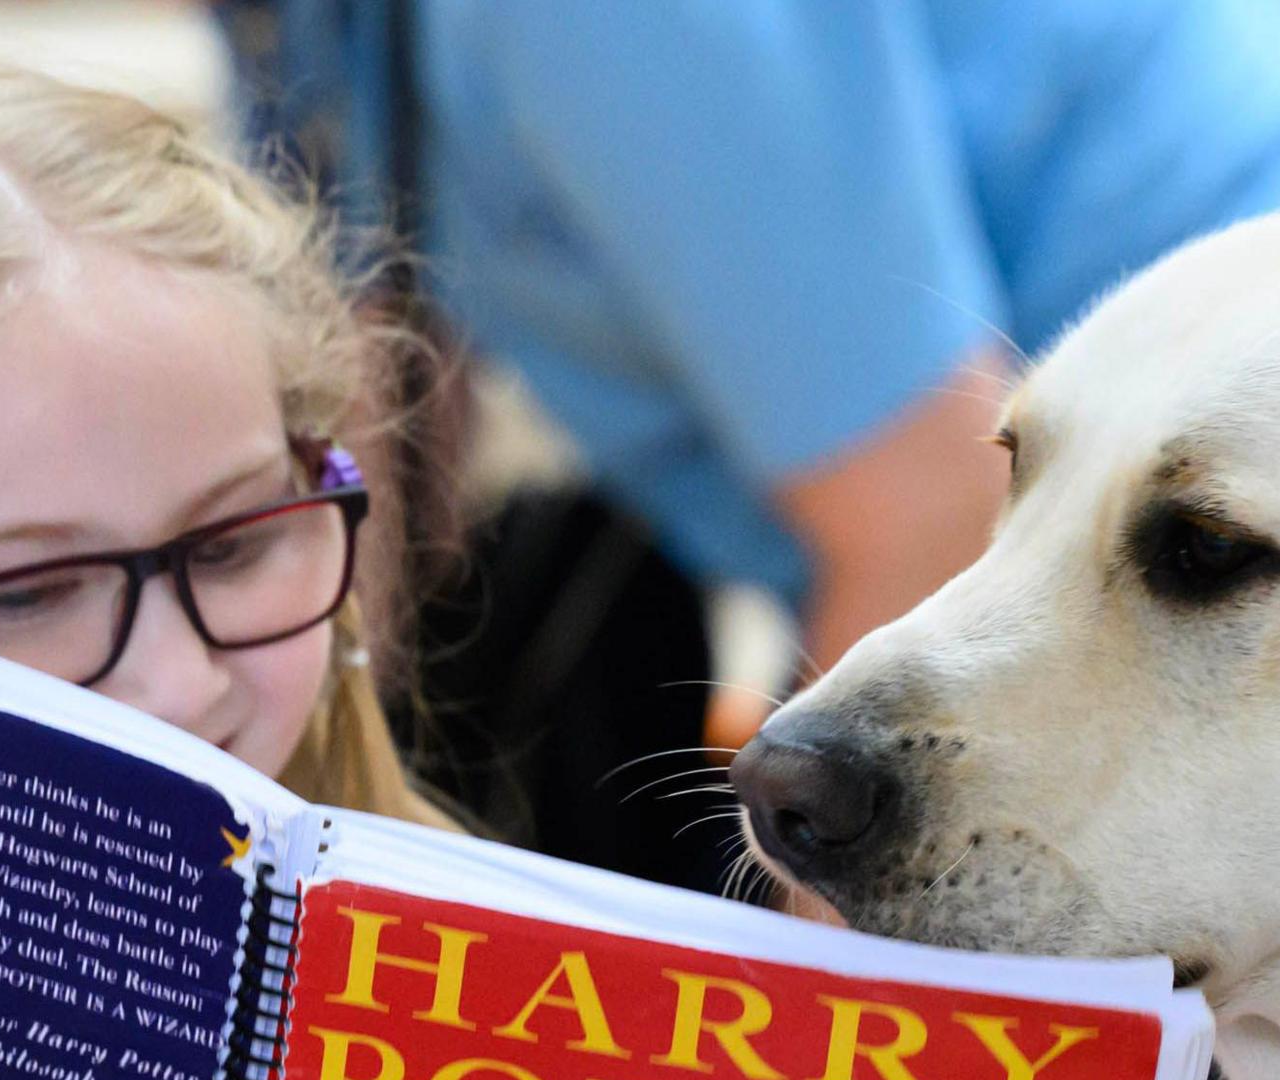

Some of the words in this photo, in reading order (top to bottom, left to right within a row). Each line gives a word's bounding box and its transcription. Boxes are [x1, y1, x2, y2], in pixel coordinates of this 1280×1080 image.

[24, 776, 88, 812] thinks
[96, 796, 120, 822] he
[127, 806, 141, 829] is
[148, 820, 171, 838] an
[41, 812, 66, 838] he
[73, 822, 88, 844] is
[95, 834, 173, 872] rescued
[180, 856, 203, 886] by
[105, 866, 172, 904] School
[178, 894, 202, 912] of
[18, 909, 57, 934] and
[63, 918, 110, 949] does
[117, 933, 174, 970] battle
[182, 954, 200, 978] in
[87, 891, 148, 928] learns
[155, 917, 175, 937] to
[180, 926, 222, 955] play
[76, 953, 117, 985] The
[26, 1020, 108, 1065] Harry
[86, 992, 104, 1013] IS
[112, 1001, 125, 1021] A
[136, 1006, 224, 1052] WIZARD
